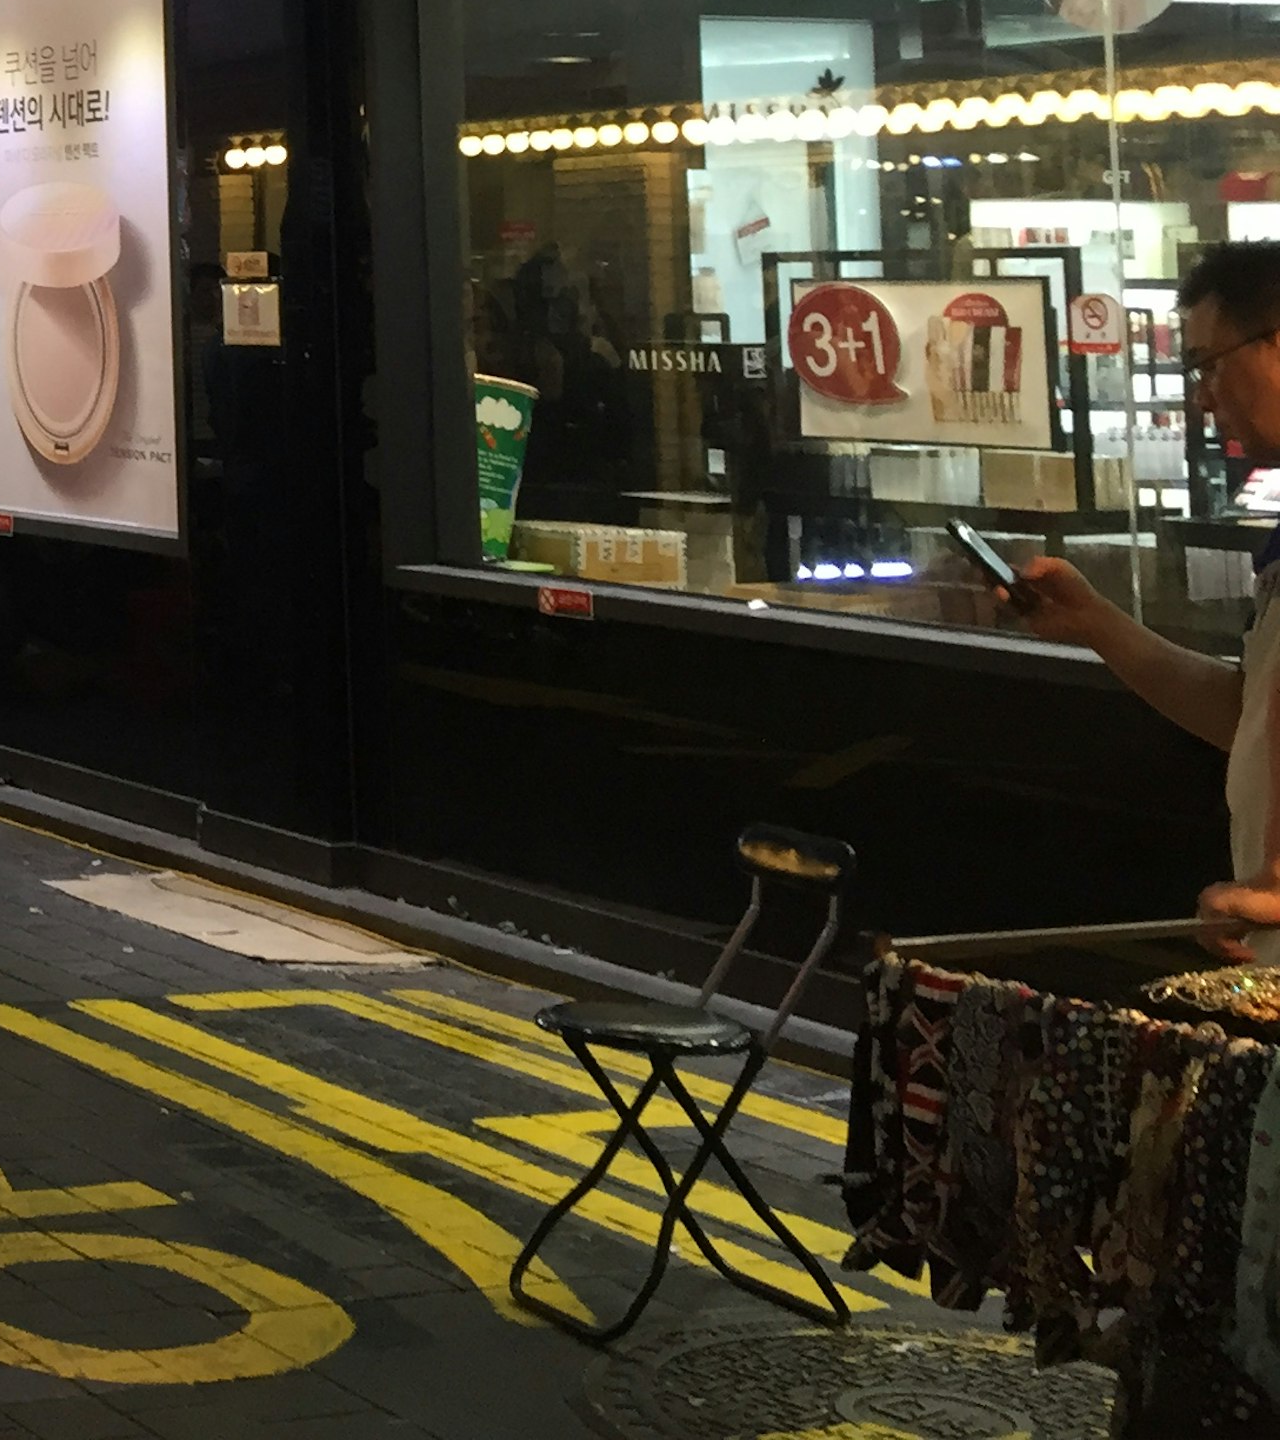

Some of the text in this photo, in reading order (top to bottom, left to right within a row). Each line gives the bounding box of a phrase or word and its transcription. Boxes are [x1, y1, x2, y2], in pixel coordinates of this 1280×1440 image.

[4, 39, 98, 87] 쿠션을 넘어
[48, 89, 110, 129] 시대로!
[627, 348, 723, 374] MISSHA
[801, 307, 887, 379] 3+1
[149, 450, 172, 464] PACT
